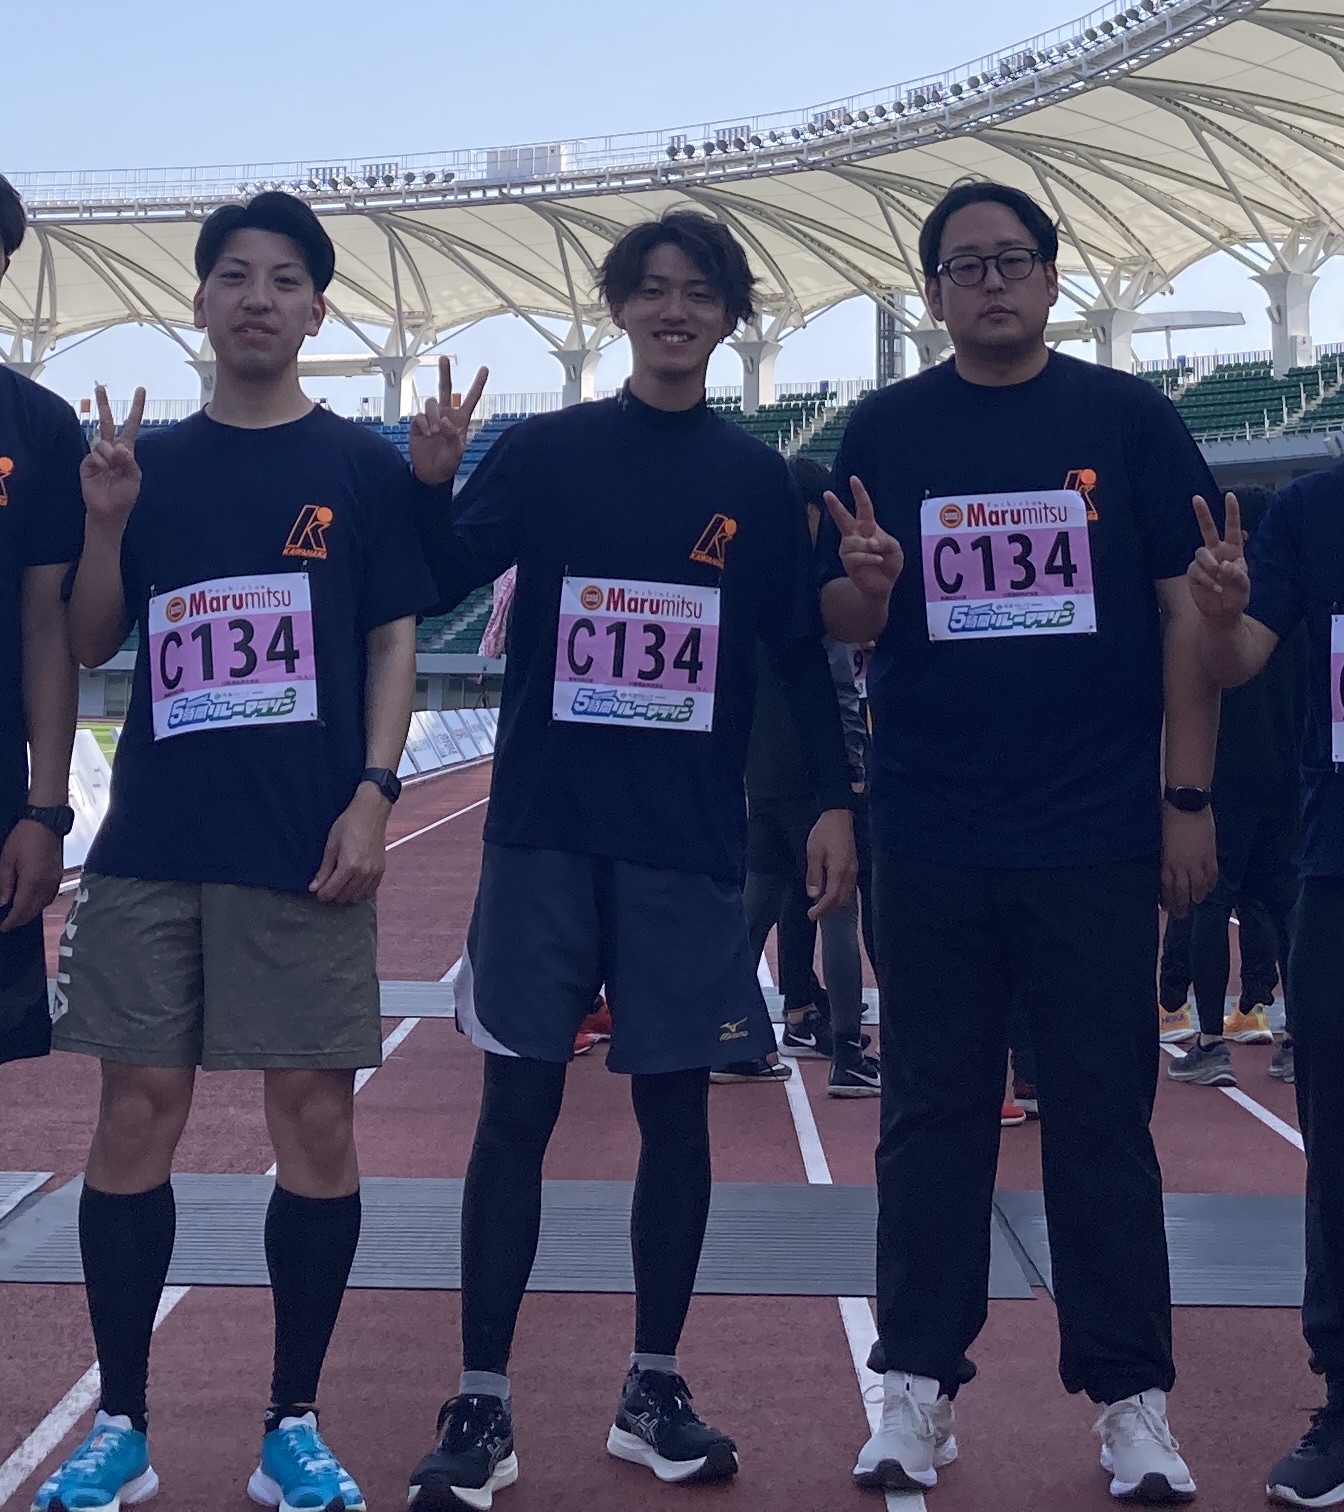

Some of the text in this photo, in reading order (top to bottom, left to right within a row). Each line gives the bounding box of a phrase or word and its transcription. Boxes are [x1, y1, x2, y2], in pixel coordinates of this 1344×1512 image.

[967, 502, 1067, 528] Marumitsu
[933, 531, 1077, 594] C134
[189, 589, 292, 618] Marumitsu
[605, 587, 702, 619] Marumitsu
[160, 615, 300, 689] C134
[567, 618, 703, 683] C134
